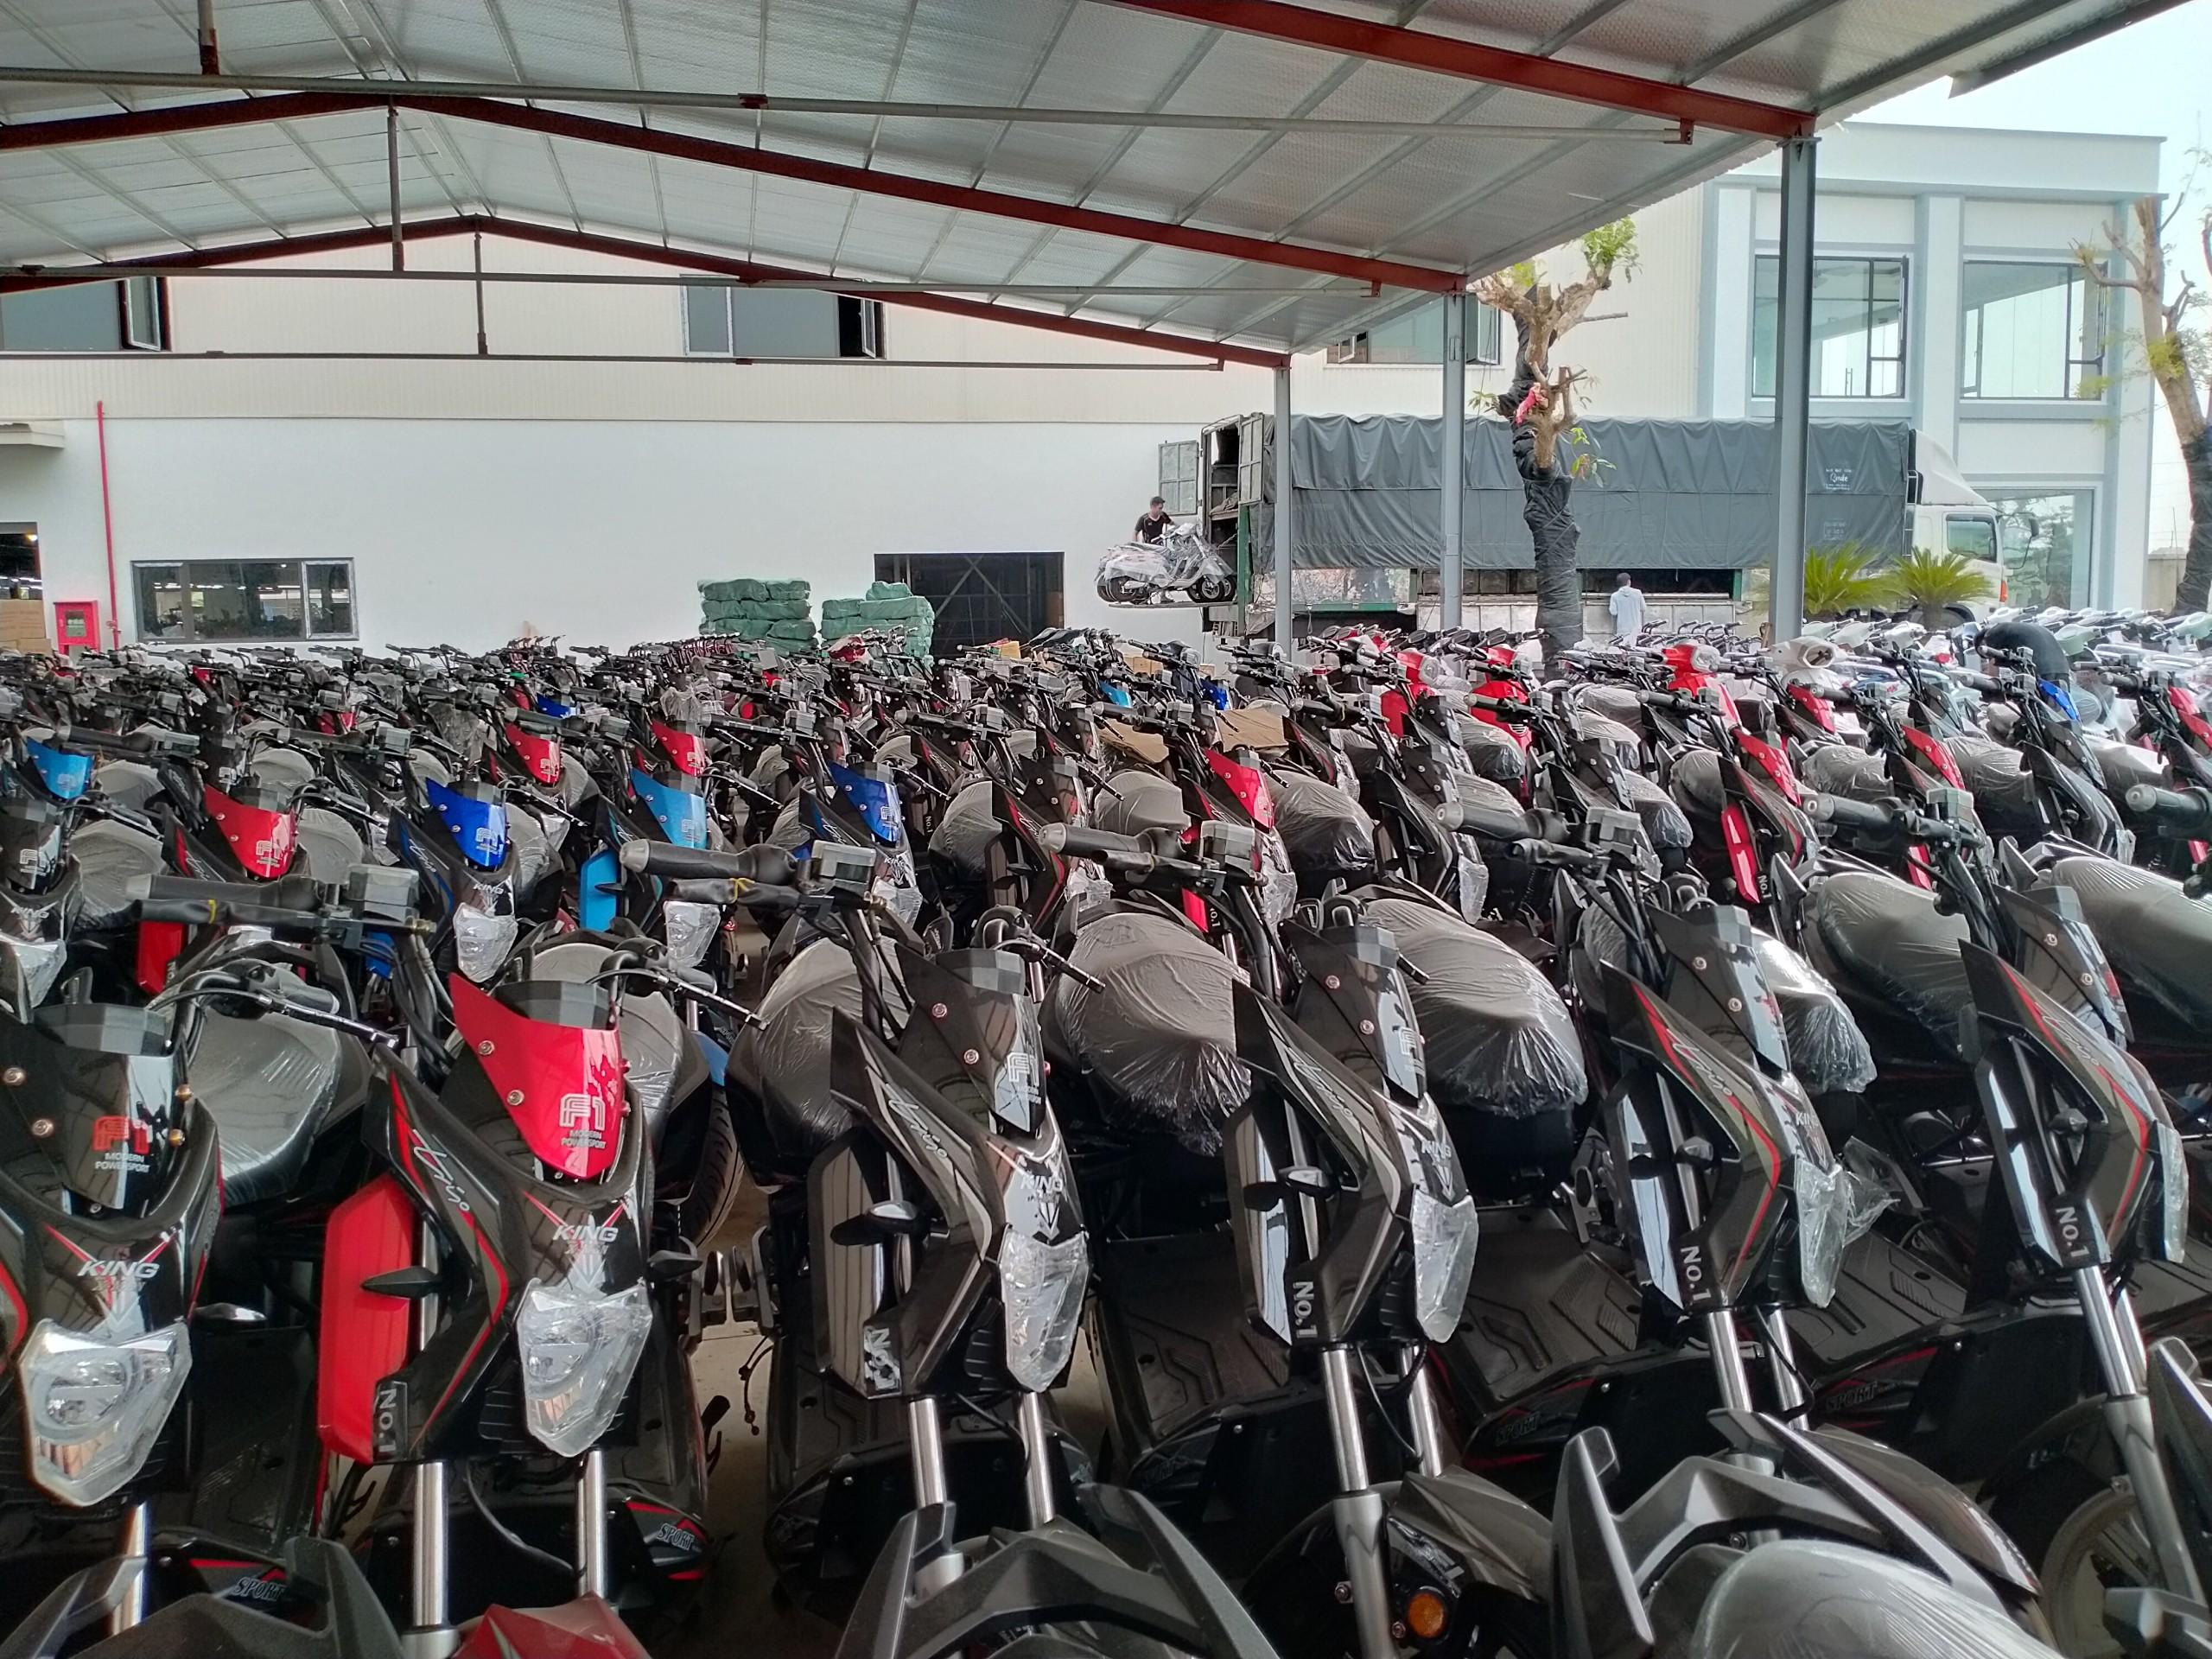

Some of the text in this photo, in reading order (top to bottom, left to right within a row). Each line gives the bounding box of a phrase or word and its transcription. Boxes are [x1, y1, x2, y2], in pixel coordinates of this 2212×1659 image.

[473, 882, 505, 895] KING
[1210, 908, 1221, 927] O.1
[558, 1093, 606, 1132] F1
[92, 1115, 152, 1154] F1
[94, 1160, 151, 1173] POWERSPORT
[104, 1152, 145, 1163] MODERN
[1020, 1173, 1064, 1192] KING
[551, 1224, 620, 1243] KING
[2056, 1206, 2090, 1257] NO.1
[76, 1260, 160, 1279] KING
[1680, 1245, 1712, 1300] NO.1
[1293, 1281, 1319, 1338] NO.1
[378, 1388, 397, 1452] NO.1
[657, 1522, 696, 1552] SPORT
[229, 1575, 287, 1603] SPORT
